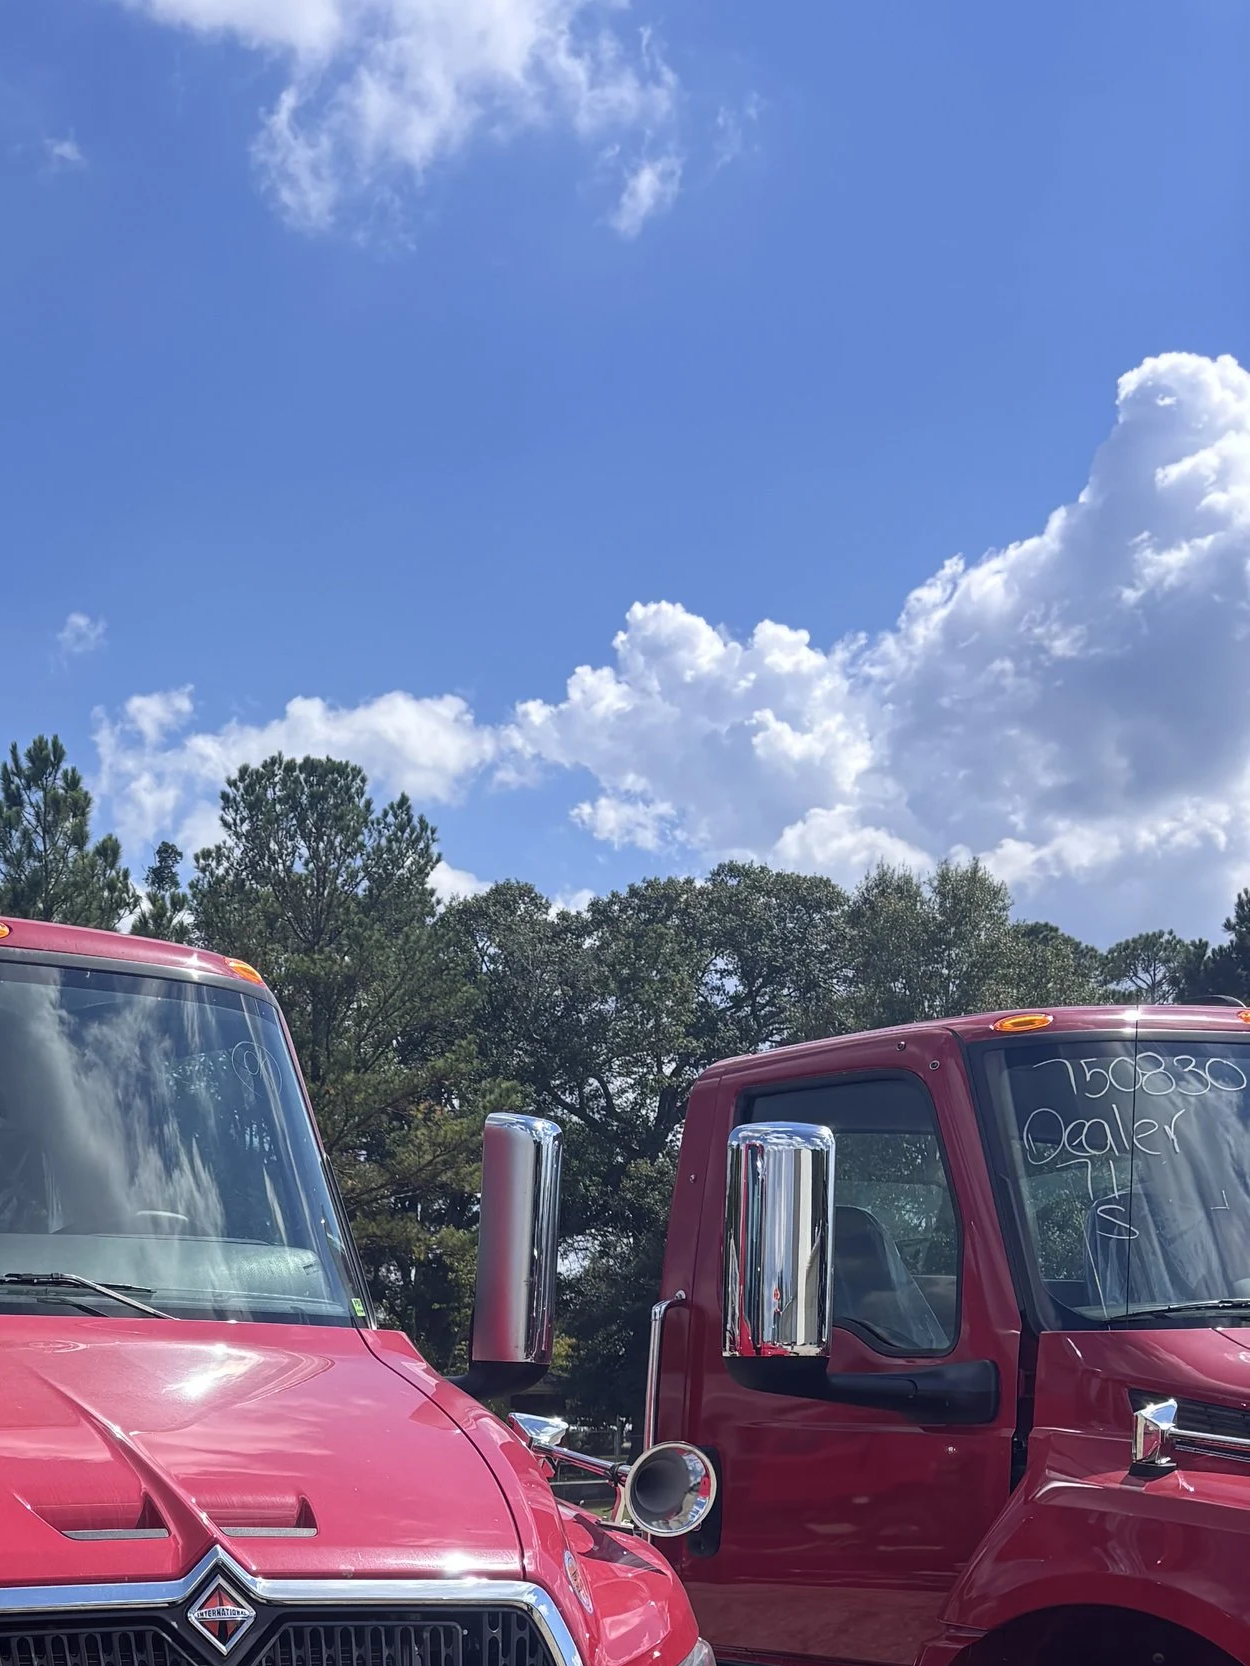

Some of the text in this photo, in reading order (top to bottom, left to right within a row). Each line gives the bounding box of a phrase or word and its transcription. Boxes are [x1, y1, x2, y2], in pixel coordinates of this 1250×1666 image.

[1032, 1051, 1247, 1098] 750830
[1023, 1103, 1185, 1165] Dealer
[196, 1607, 248, 1618] INTERNATIONAL
